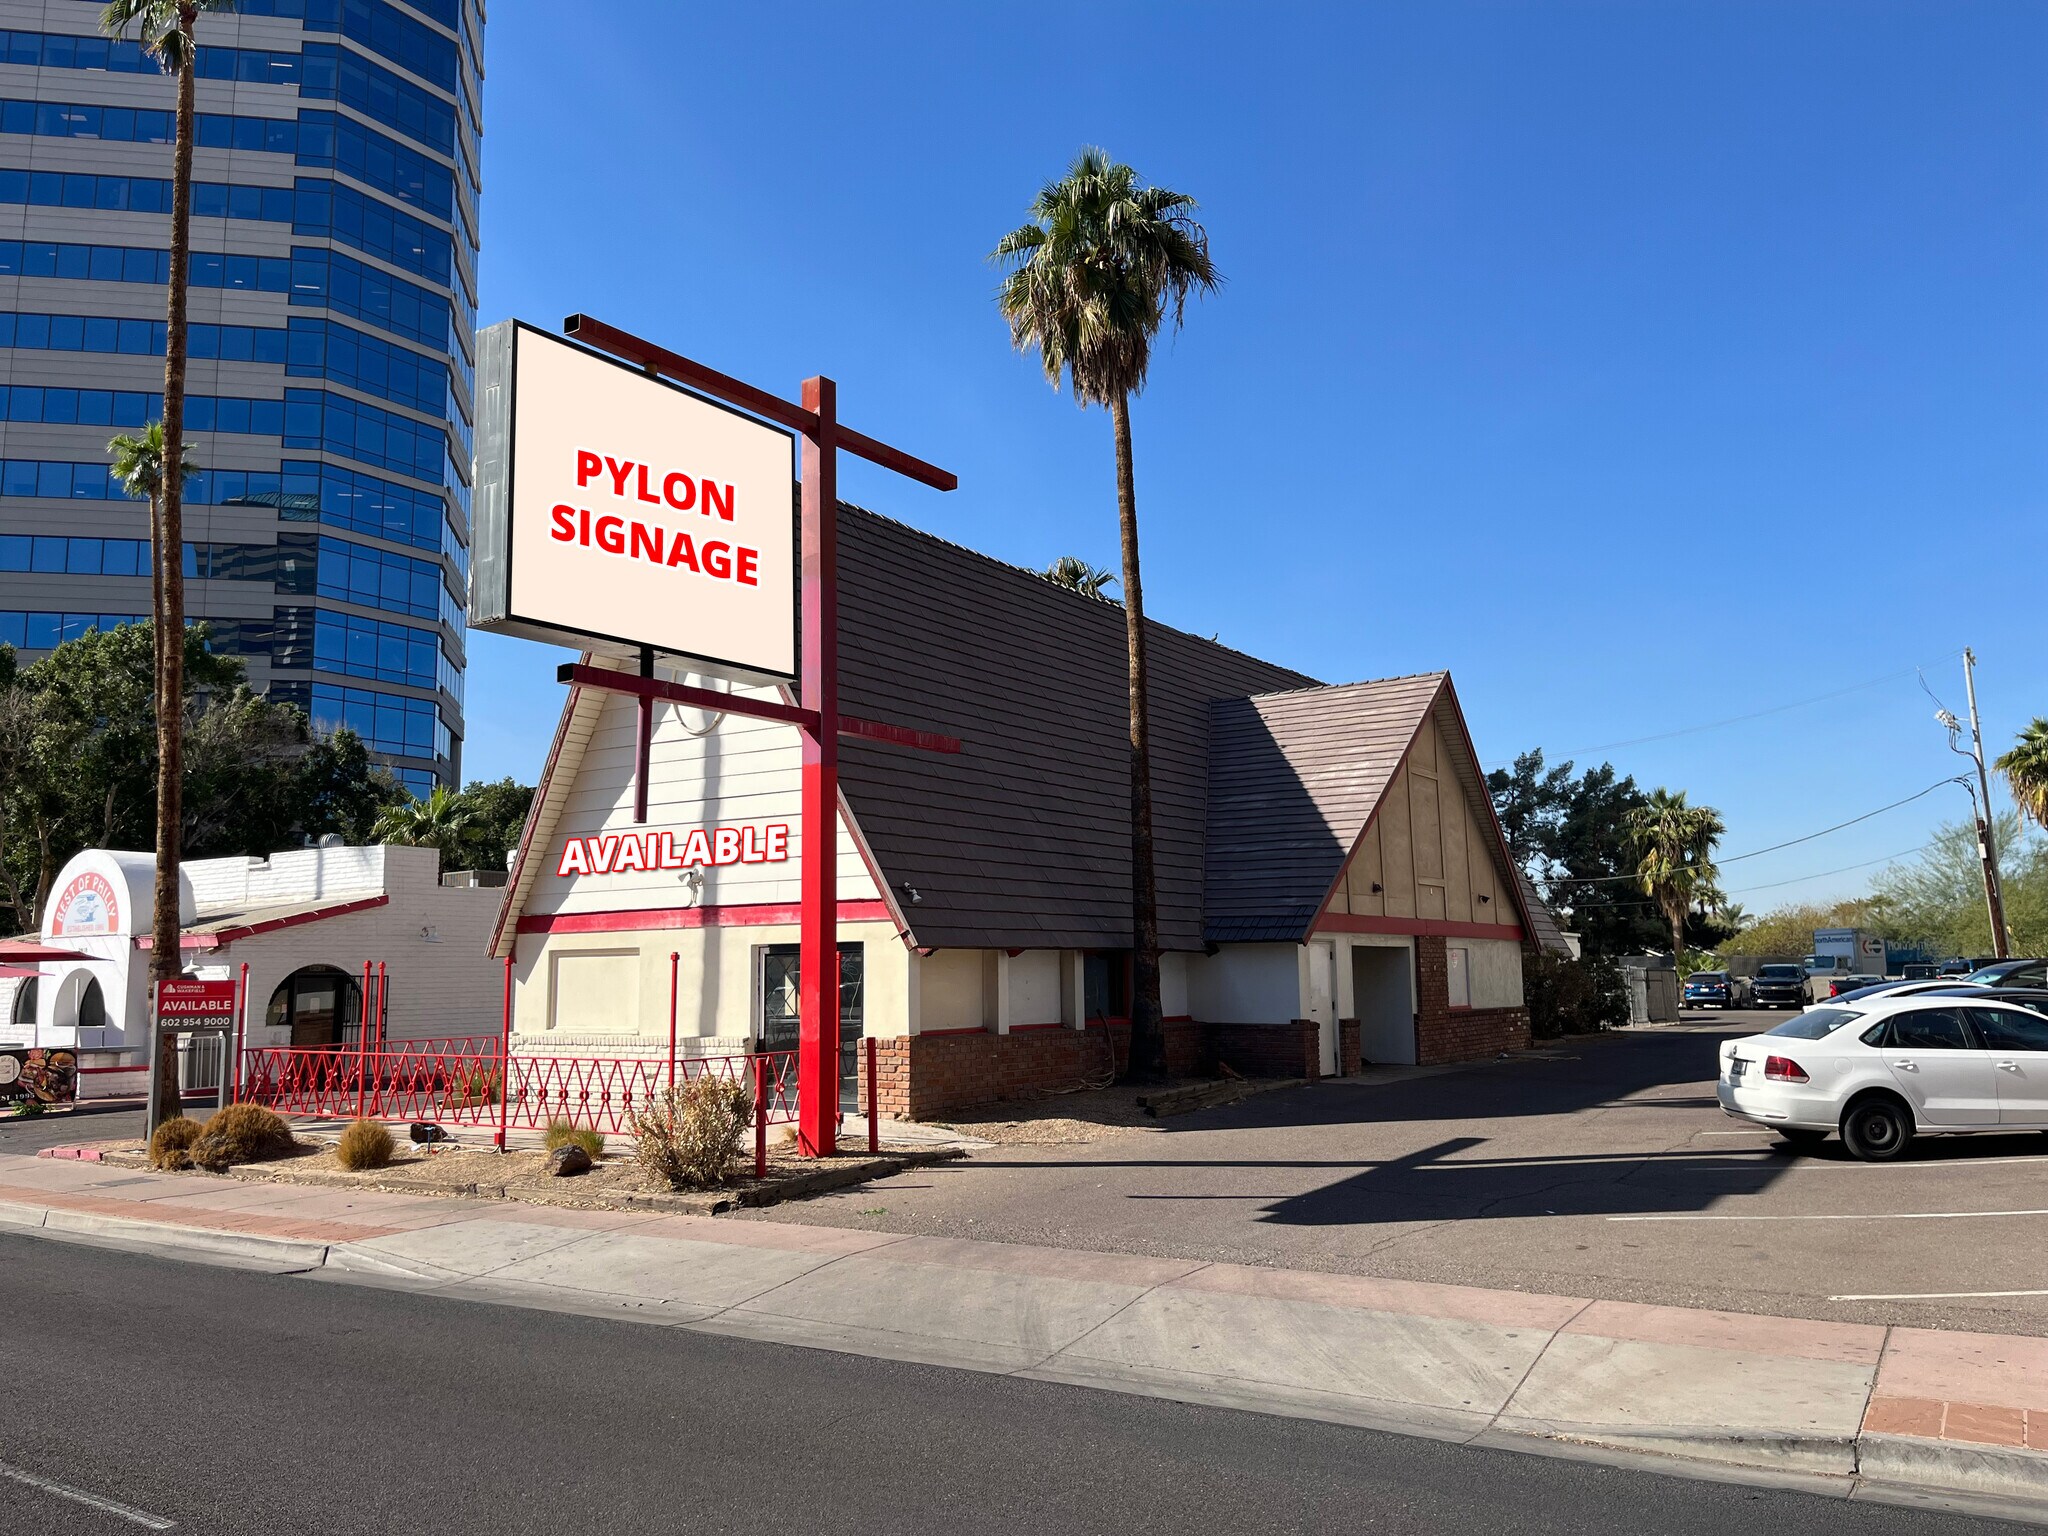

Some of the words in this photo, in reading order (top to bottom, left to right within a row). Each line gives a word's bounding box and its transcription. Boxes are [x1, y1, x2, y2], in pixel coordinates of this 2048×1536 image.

[56, 884, 76, 922] BEST
[78, 875, 90, 890] OF
[92, 876, 116, 917] PHILLY
[1815, 936, 1853, 944] northAmerican
[162, 1000, 232, 1011] AVAILABLE
[161, 1018, 180, 1027] 602
[183, 1018, 201, 1026] 954
[204, 1017, 230, 1026] 9000
